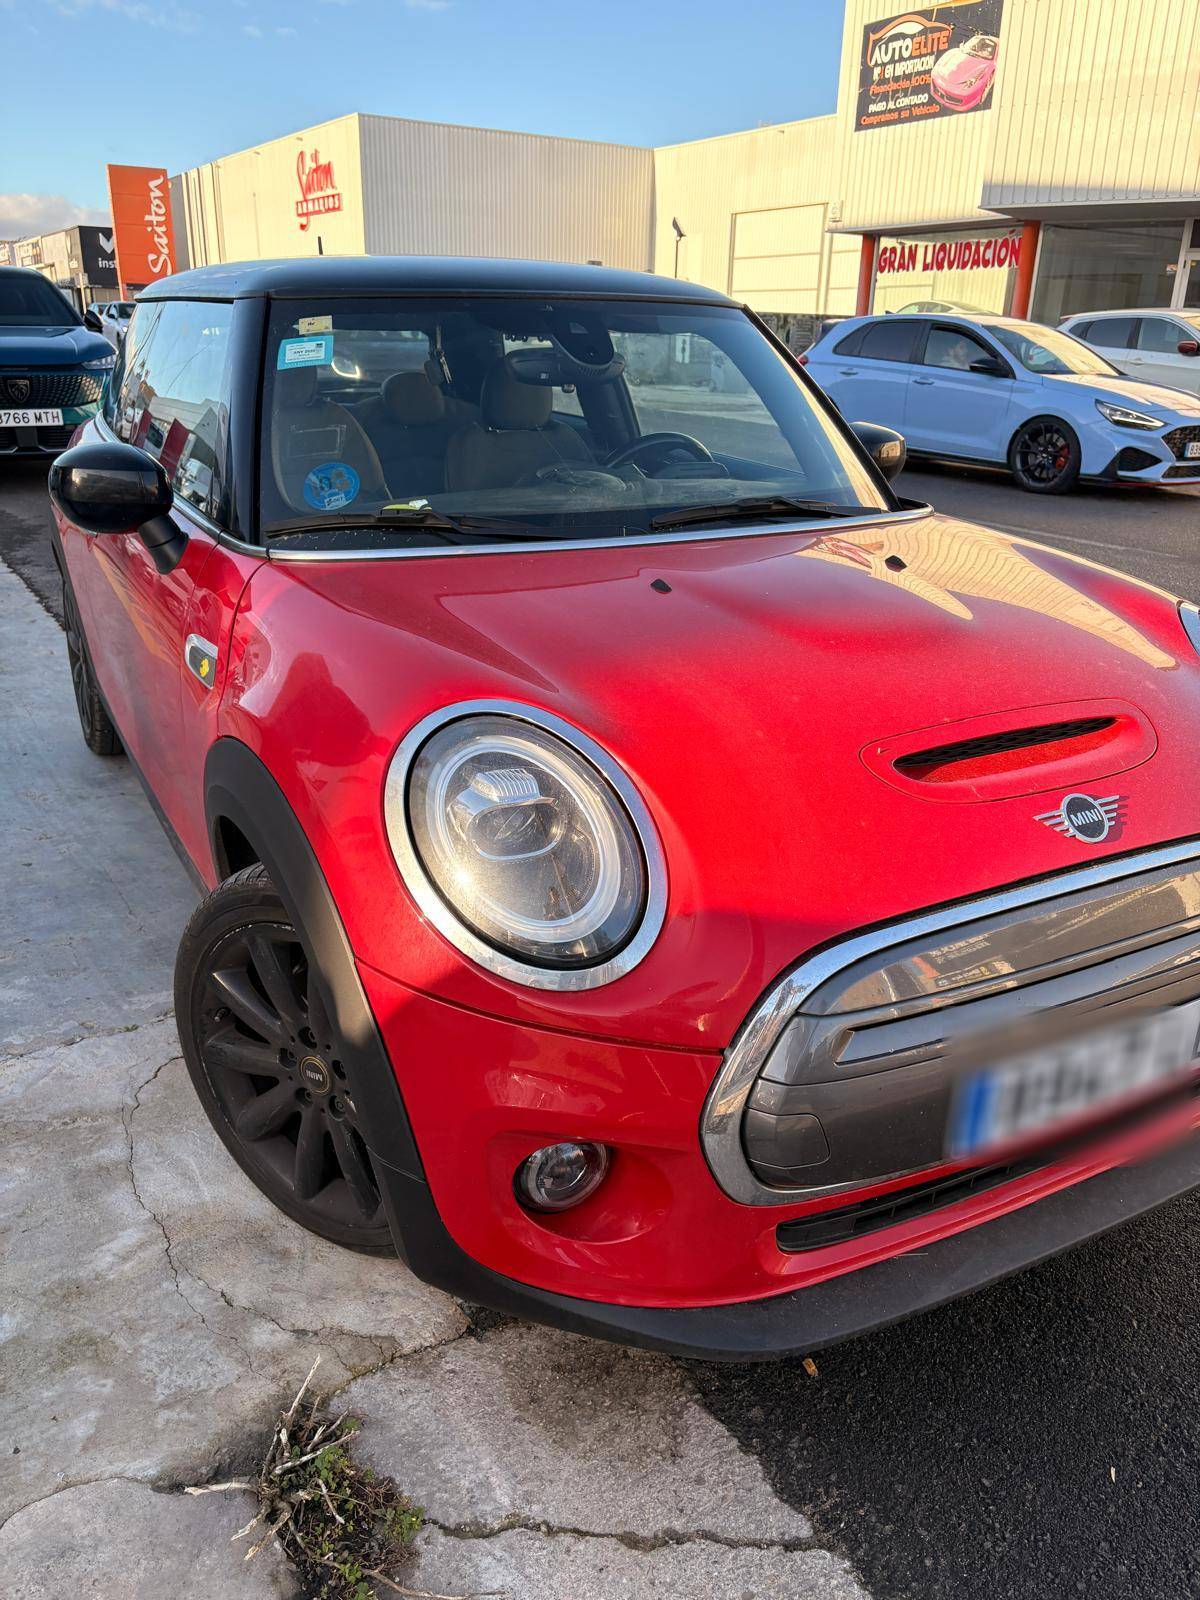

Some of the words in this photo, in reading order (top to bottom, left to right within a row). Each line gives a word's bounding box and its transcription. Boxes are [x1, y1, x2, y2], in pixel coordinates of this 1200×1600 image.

[868, 101, 887, 113] PAGO
[887, 100, 896, 110] AL
[896, 93, 929, 108] CONTADO
[861, 111, 899, 125] Compramos
[900, 109, 909, 119] su
[144, 175, 173, 276] Saiton
[878, 243, 918, 274] GRAN
[922, 229, 1022, 272] LIQUIDACIÓN
[98, 257, 118, 269] ins
[34, 410, 60, 424] MTH
[1070, 808, 1102, 827] MINI
